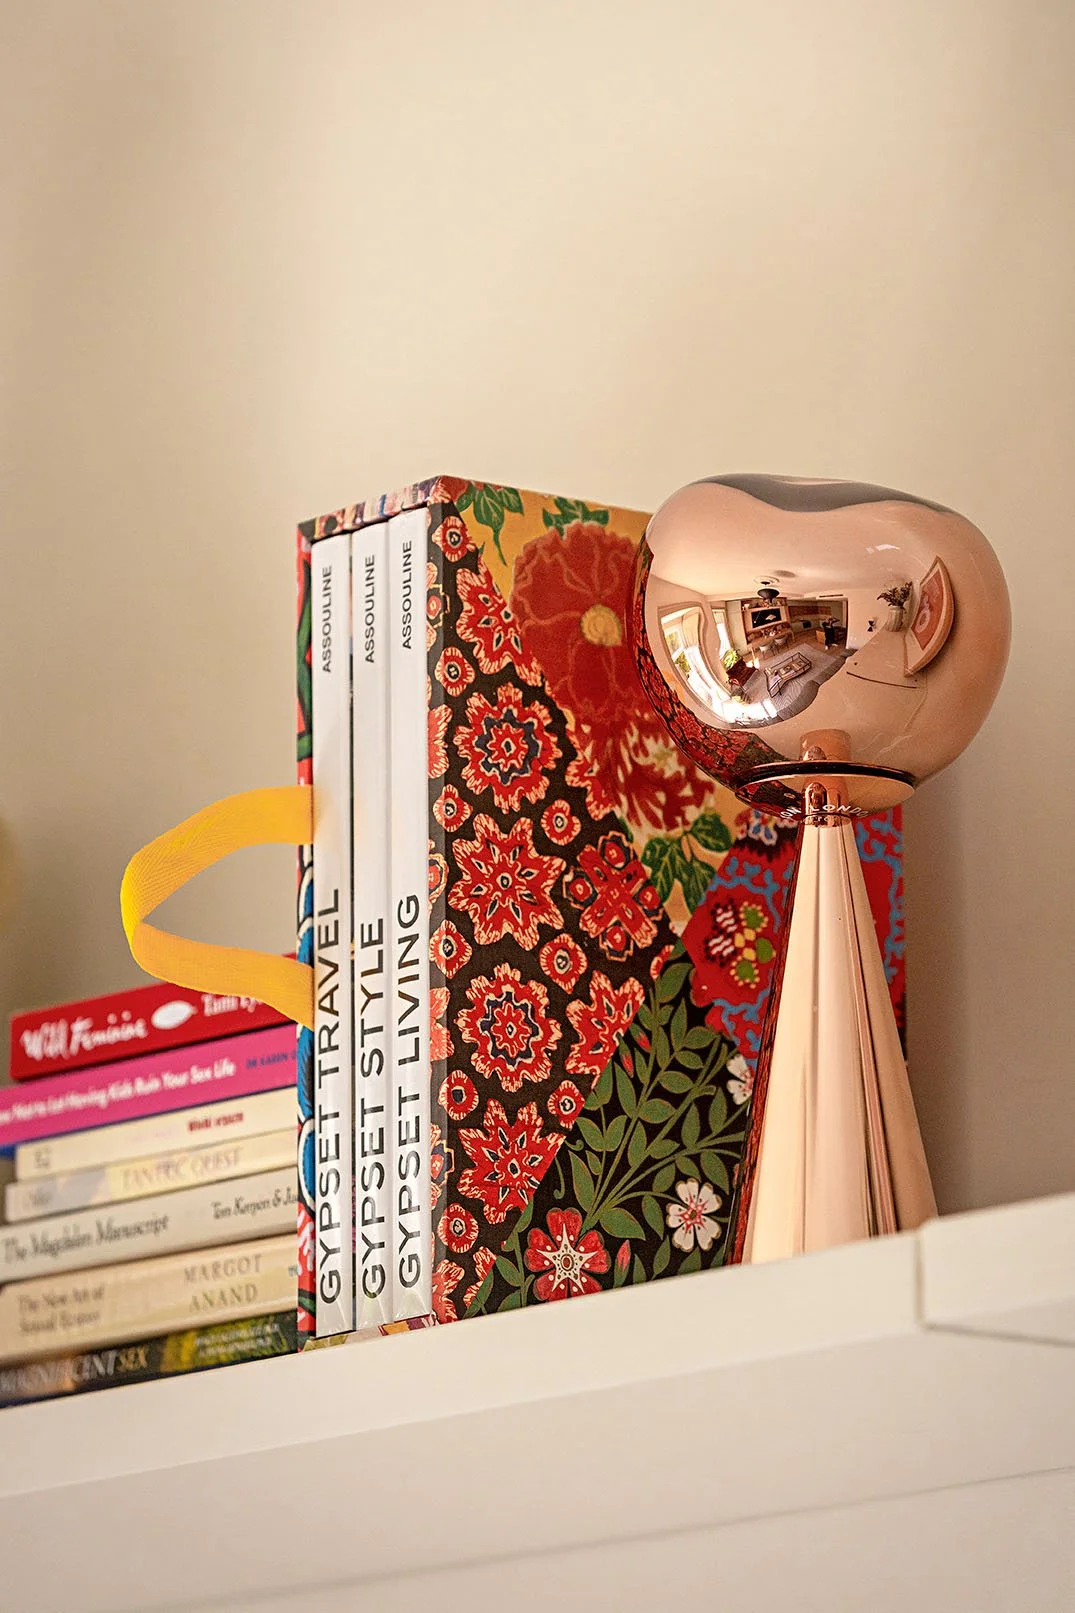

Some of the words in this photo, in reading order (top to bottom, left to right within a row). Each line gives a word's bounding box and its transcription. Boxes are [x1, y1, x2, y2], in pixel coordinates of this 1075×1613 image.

[322, 565, 332, 673] ASSOULINE
[365, 554, 375, 663] ASSOULINE
[402, 540, 412, 650] ASSOULINE
[318, 888, 340, 1090] TRAVEL
[360, 918, 385, 1078] STYLE
[397, 894, 420, 1066] LIVING
[20, 1018, 70, 1061] Wild
[69, 1010, 149, 1056] Feminine
[108, 1080, 133, 1101] Kids
[162, 1070, 189, 1090] Your
[190, 1065, 212, 1084] Sex
[213, 1057, 236, 1079] Life
[4, 1236, 28, 1263] The
[95, 1214, 169, 1245] Manuscript
[211, 1201, 232, 1220] Tom
[319, 1104, 342, 1304] GYPSET
[361, 1097, 386, 1299] GYPSET
[398, 1086, 421, 1288] GYPSET
[183, 1254, 261, 1285] MARGOT
[189, 1283, 258, 1313] ANAND
